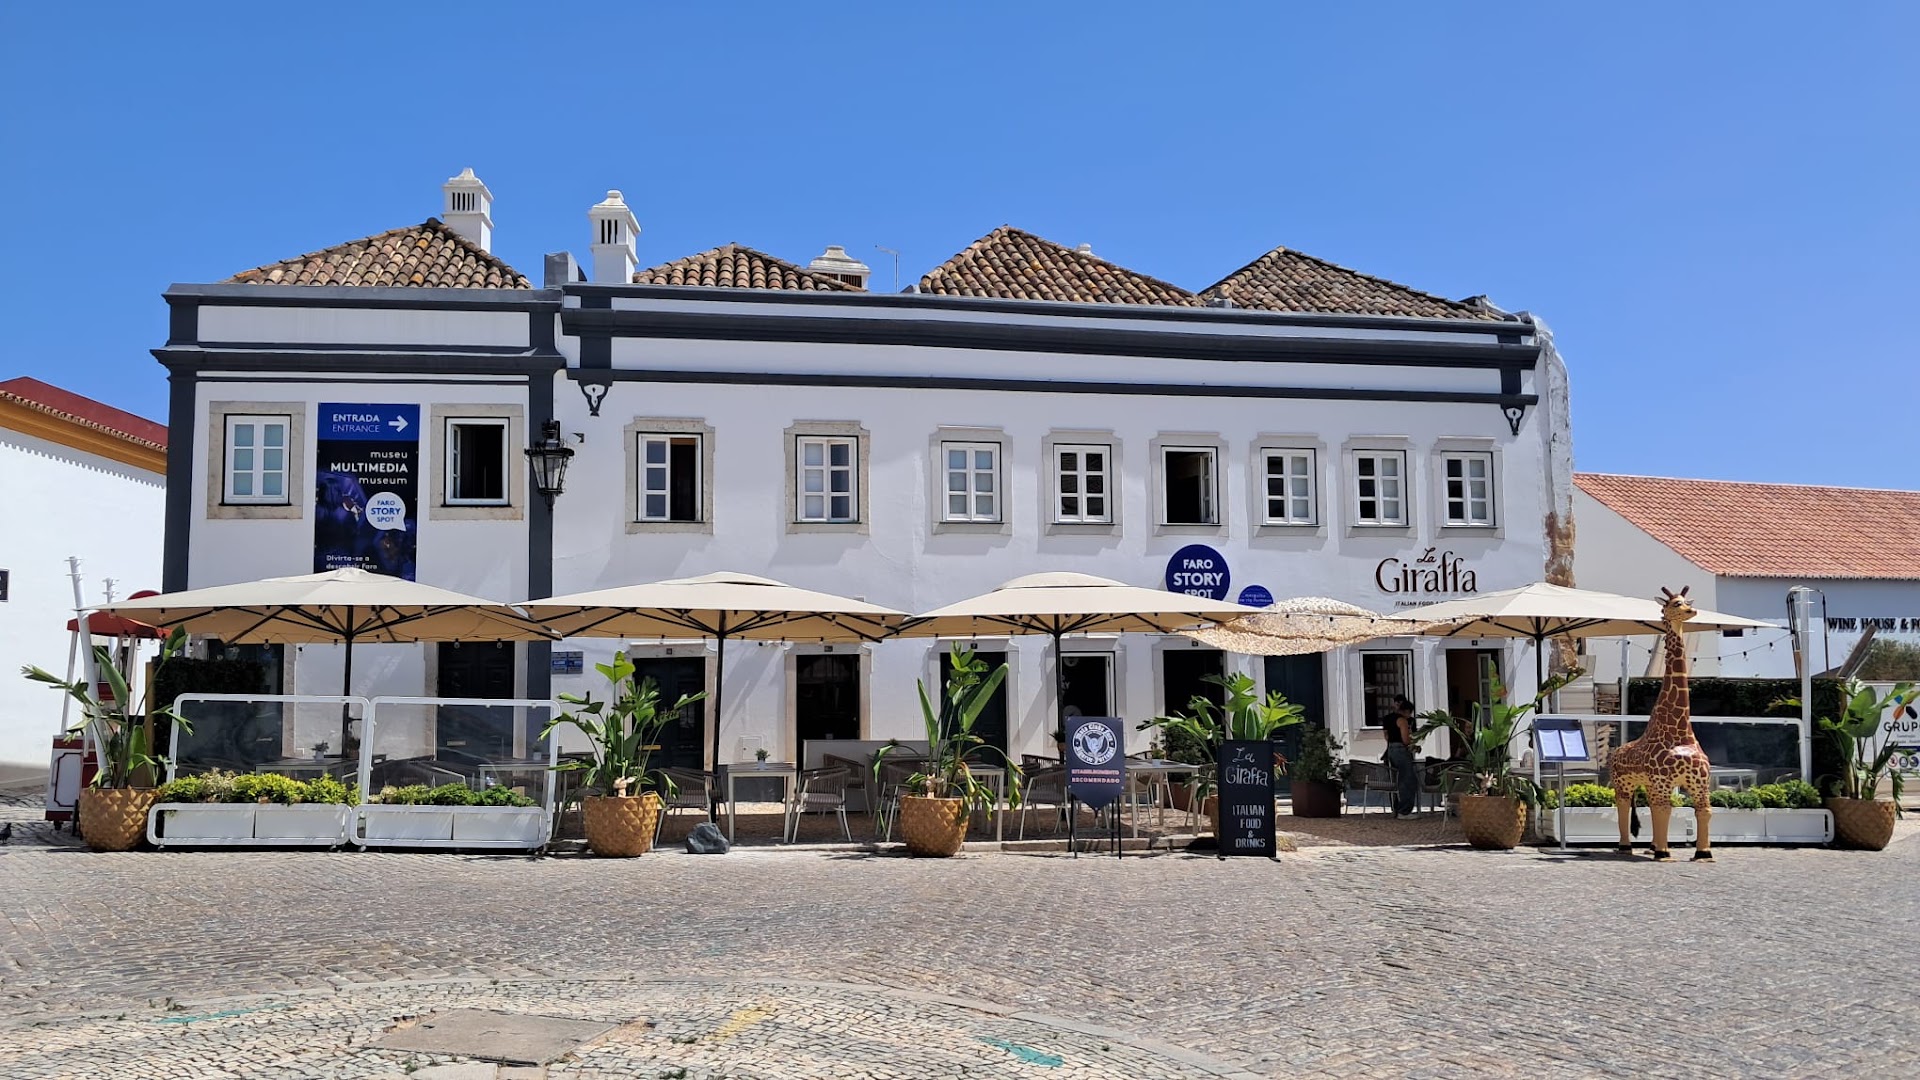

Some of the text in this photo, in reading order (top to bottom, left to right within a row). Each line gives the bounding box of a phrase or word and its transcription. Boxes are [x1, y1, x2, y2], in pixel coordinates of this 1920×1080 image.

[332, 413, 380, 423] ENTRADA
[332, 424, 380, 433] ENTRANCE
[370, 451, 408, 459] museu
[330, 462, 408, 473] MULTIMEDIA
[358, 477, 408, 485] museum
[370, 507, 401, 515] STORY
[1416, 547, 1438, 563] La
[1183, 559, 1214, 570] FARO
[1375, 550, 1478, 593] Giraffa
[1173, 572, 1223, 586] STORY
[1826, 617, 1857, 630] WINE
[1861, 617, 1896, 630] HOUSE
[1900, 617, 1909, 630] &
[1883, 721, 1920, 732] GRUP
[1231, 746, 1255, 763] La
[1225, 764, 1268, 787] Giraffa
[1232, 805, 1265, 816] ITALIAN
[1239, 818, 1262, 829] FOOD
[1247, 830, 1255, 838] &
[1235, 838, 1266, 848] DRINKS
